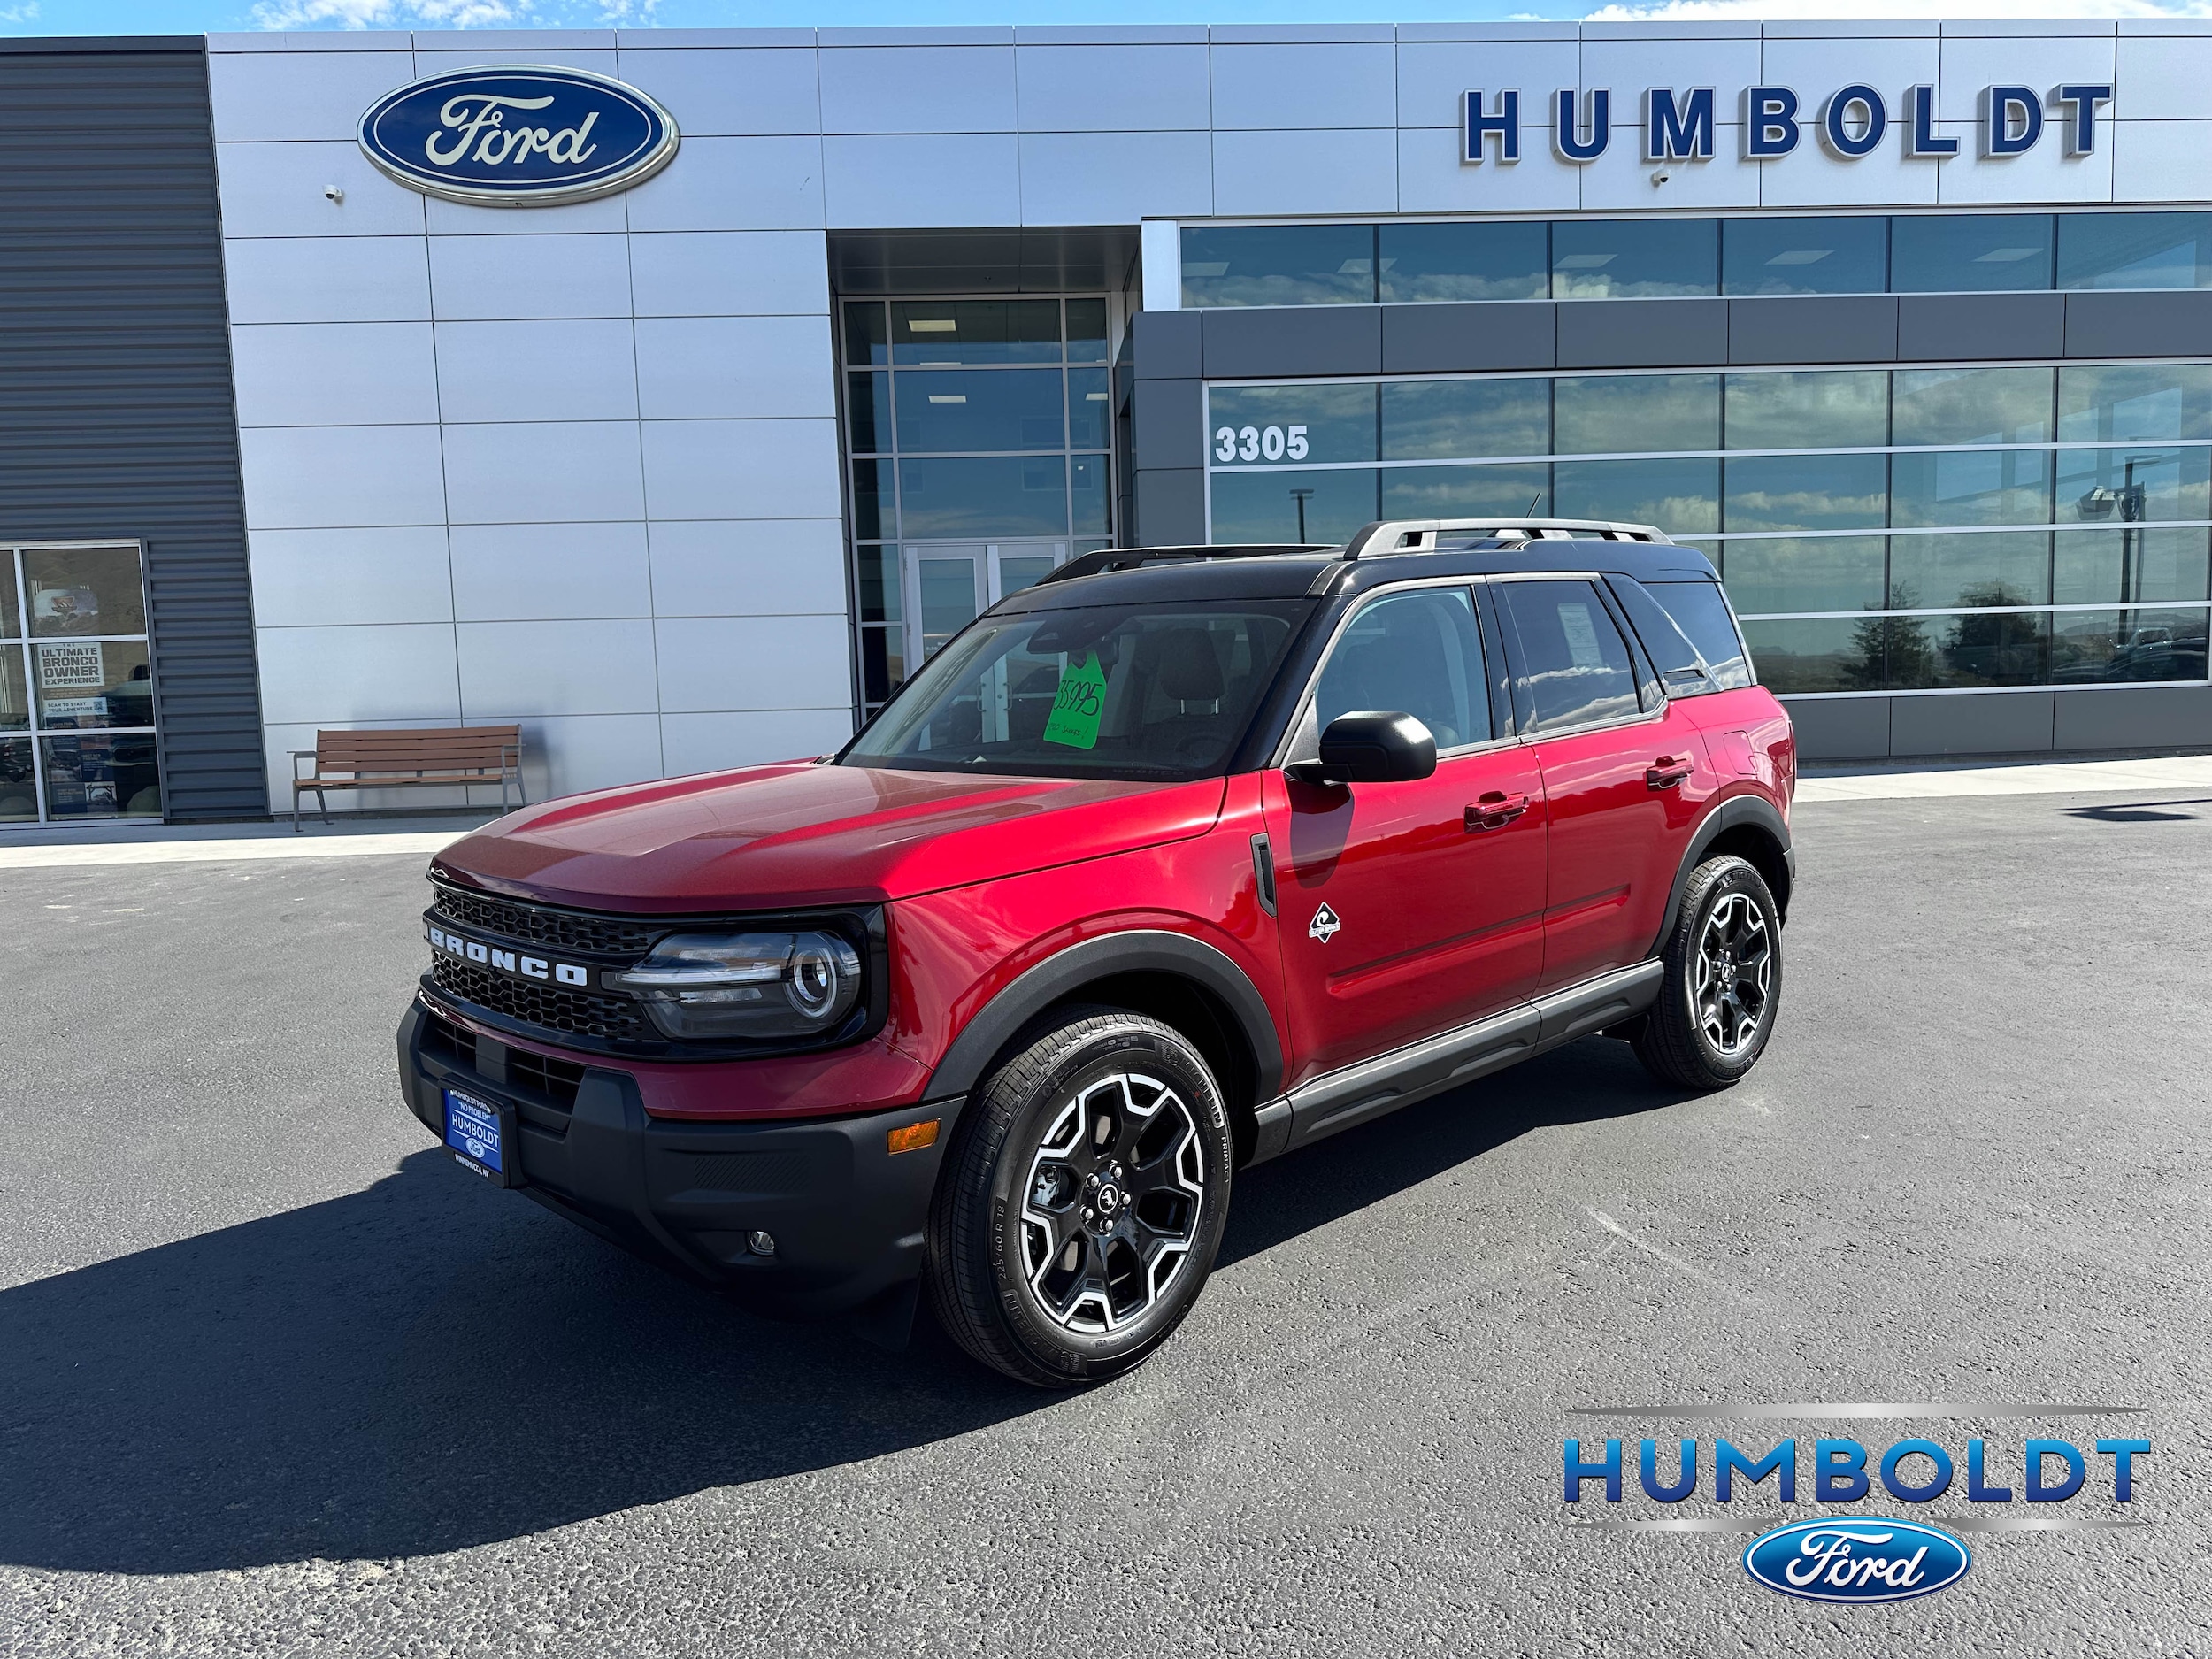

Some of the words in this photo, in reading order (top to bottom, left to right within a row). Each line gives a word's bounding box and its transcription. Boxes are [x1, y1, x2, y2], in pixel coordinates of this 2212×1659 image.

[425, 94, 599, 166] Ford
[1461, 81, 2114, 165] HUMBOLDT
[1215, 425, 1310, 462] 3305
[42, 648, 97, 657] ULTIMATE
[42, 656, 98, 667] BRONCO
[43, 666, 99, 678] OWNER
[45, 677, 100, 686] EXPERIENCE
[430, 927, 588, 987] BRONCO
[451, 1114, 499, 1148] HUMBOLDT
[996, 1205, 1005, 1217] 18
[995, 1223, 1003, 1232] R
[993, 1236, 1007, 1279] 225/60
